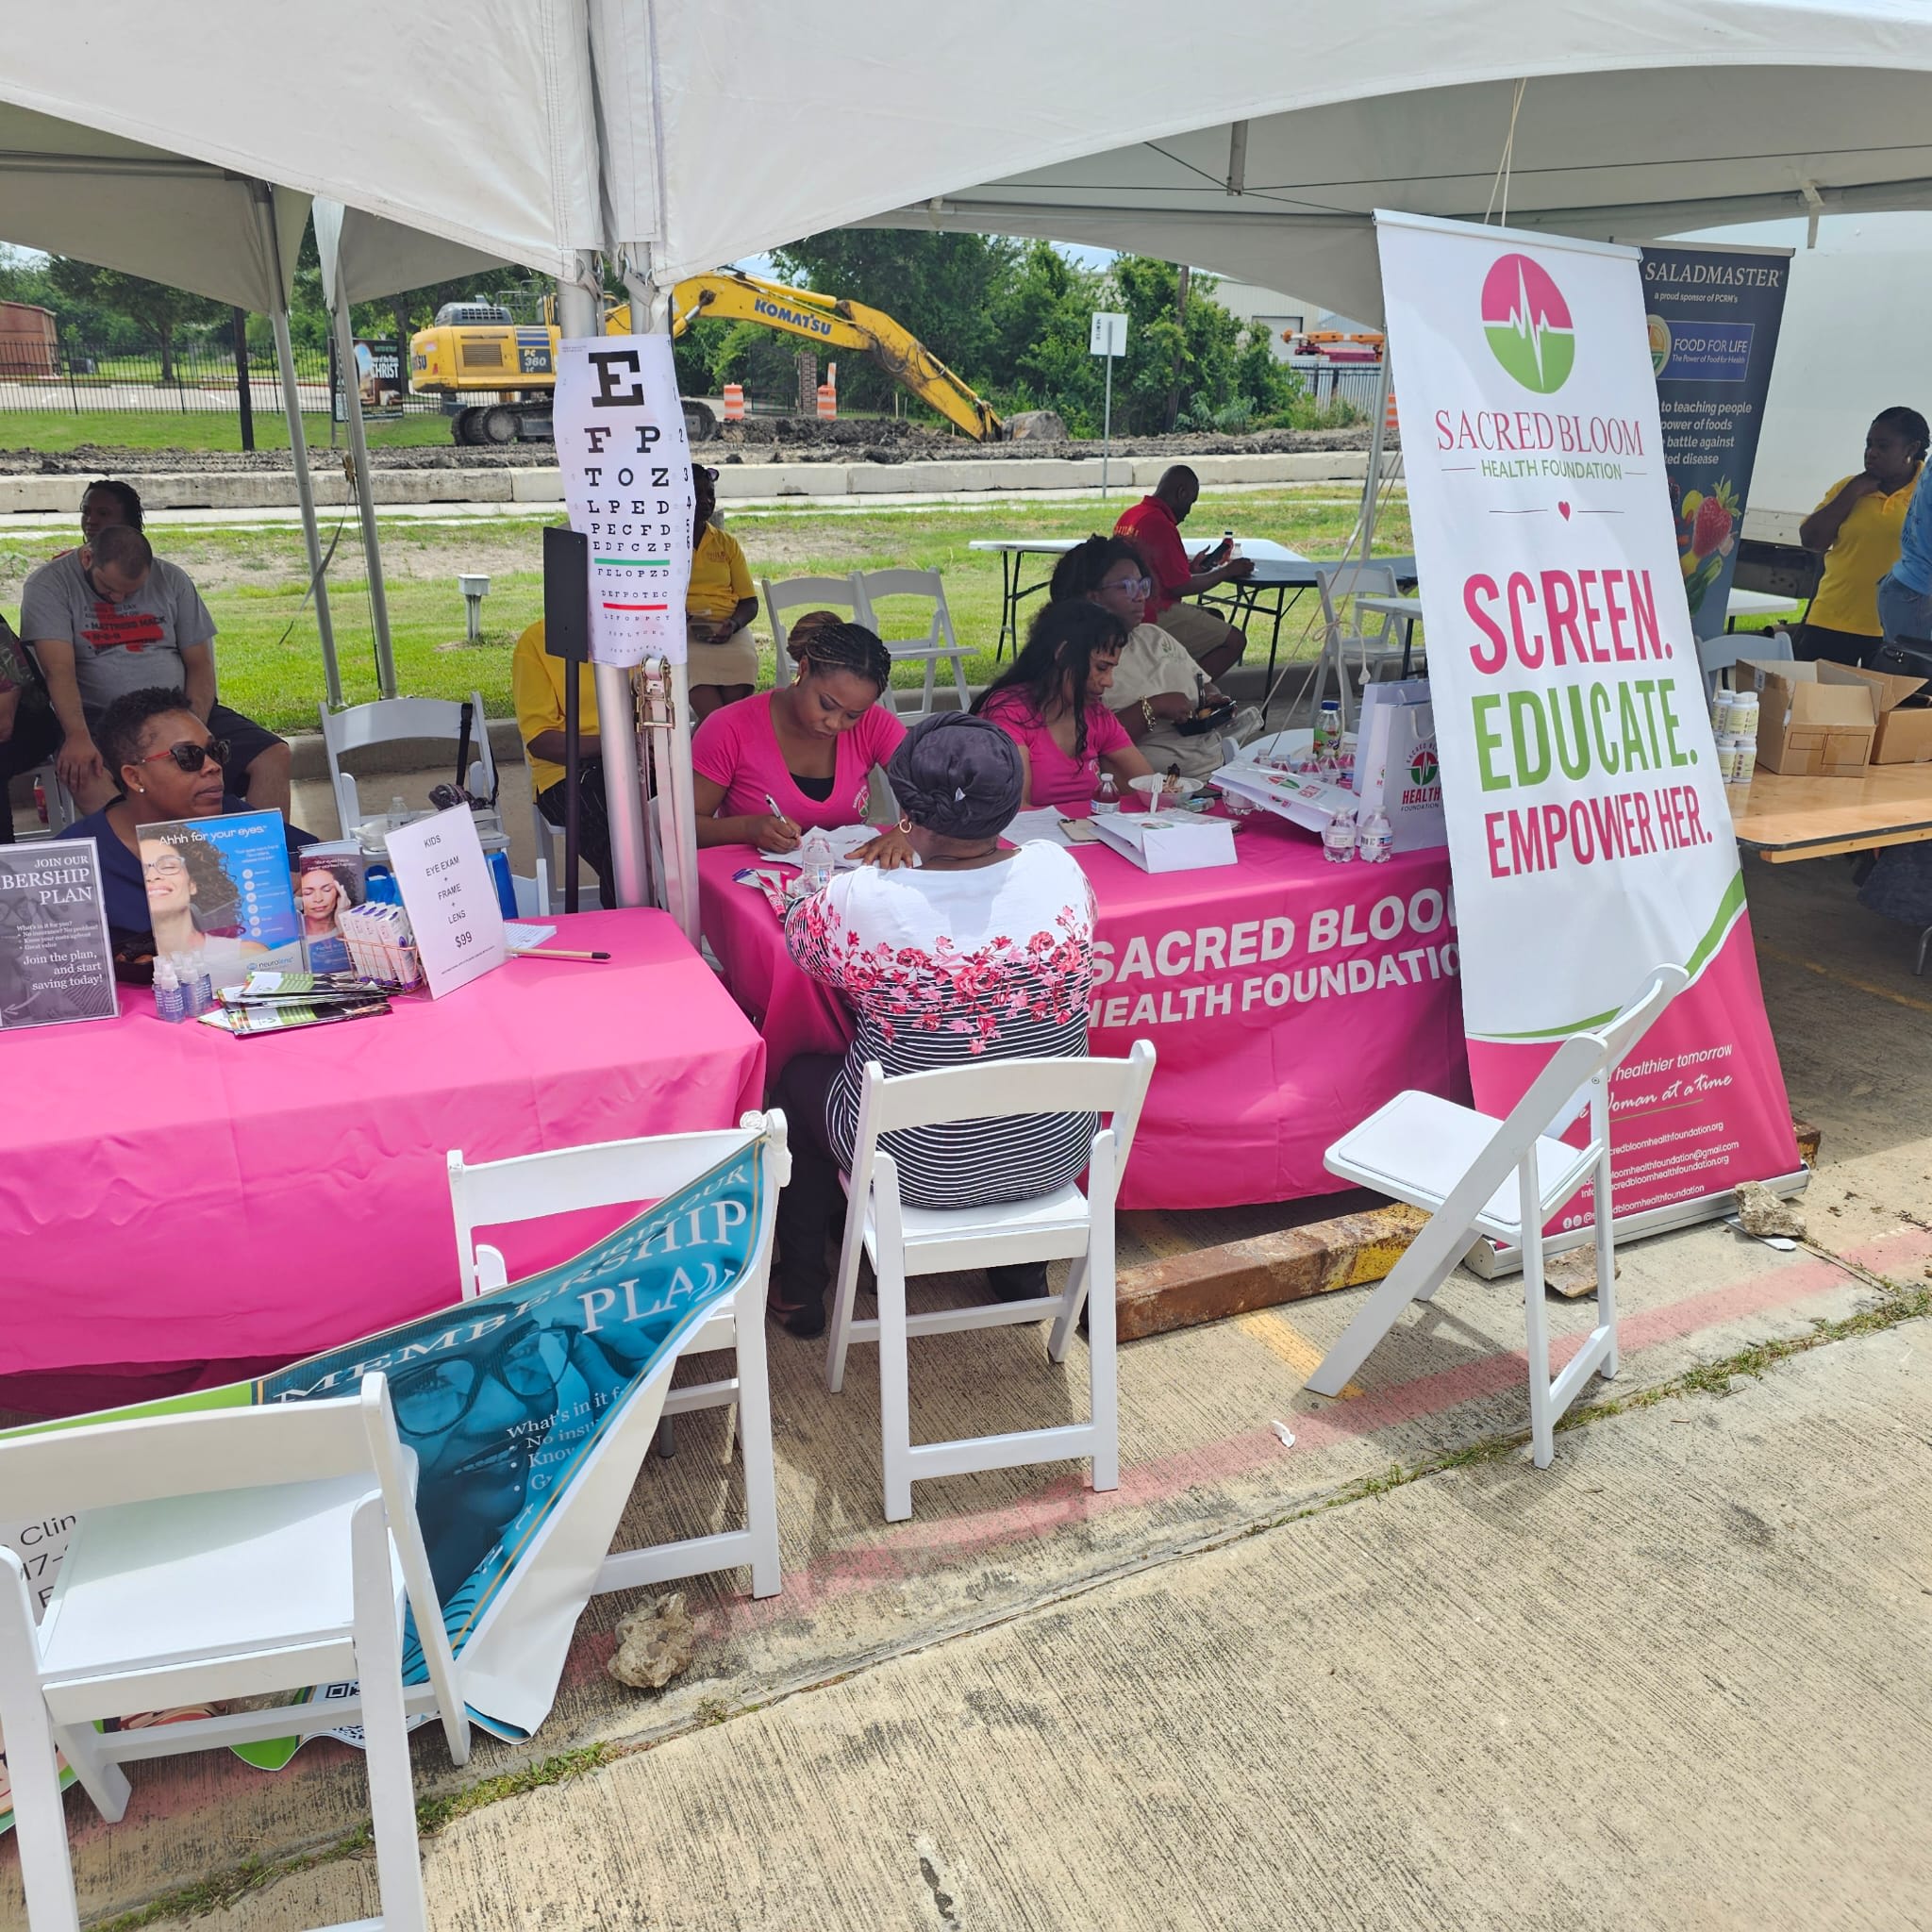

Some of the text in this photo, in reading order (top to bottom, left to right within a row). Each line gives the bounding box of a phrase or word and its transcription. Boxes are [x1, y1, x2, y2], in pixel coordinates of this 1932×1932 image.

[1644, 262, 1780, 288] SALADMASTER
[1659, 291, 1680, 302] proud
[1680, 293, 1706, 303] sponsor
[1707, 293, 1715, 302] of
[755, 298, 832, 336] KOMATSU
[1674, 339, 1748, 354] FOOD FOR LIFE
[525, 357, 547, 366] 360
[589, 350, 644, 408] E
[1661, 400, 1753, 416] to teaching people
[1435, 409, 1645, 457] SACRED BLOOM
[1660, 418, 1733, 431] power of foods
[1667, 435, 1735, 450] battle against
[1682, 453, 1719, 465] disease
[1481, 458, 1623, 480] HEALTH FOUNDATION
[1463, 569, 1674, 675] SCREEN.
[1472, 678, 1699, 792] EDUCATE.
[1402, 787, 1442, 805] HEALTH
[1401, 802, 1440, 812] FOUNDATION
[158, 833, 189, 845] Ahhh
[191, 831, 208, 841] for
[209, 830, 236, 841] your
[1484, 785, 1713, 879] EMPOWER HER.
[424, 835, 441, 848] KIDS
[34, 855, 90, 869] JOIN OUR
[425, 856, 460, 876] EYE EXAM
[0, 868, 91, 891] BERSHIP
[39, 887, 93, 906] PLAN
[438, 883, 462, 901] FRAME
[448, 909, 466, 924] LENS
[455, 931, 473, 948] $99
[1091, 884, 1457, 988] SACRED BLOO
[24, 949, 97, 966] Join the plan,
[54, 961, 102, 975] and start
[32, 974, 104, 991] saving today!
[1615, 1043, 1733, 1082] healthier tomorrow
[1661, 1079, 1683, 1101] at
[1693, 1073, 1733, 1092] time
[1610, 1141, 1740, 1180] loomhealthfoundation@gmail.com
[506, 1409, 571, 1440] What's
[573, 1401, 591, 1417] in
[594, 1392, 608, 1407] it
[526, 1435, 554, 1449] No
